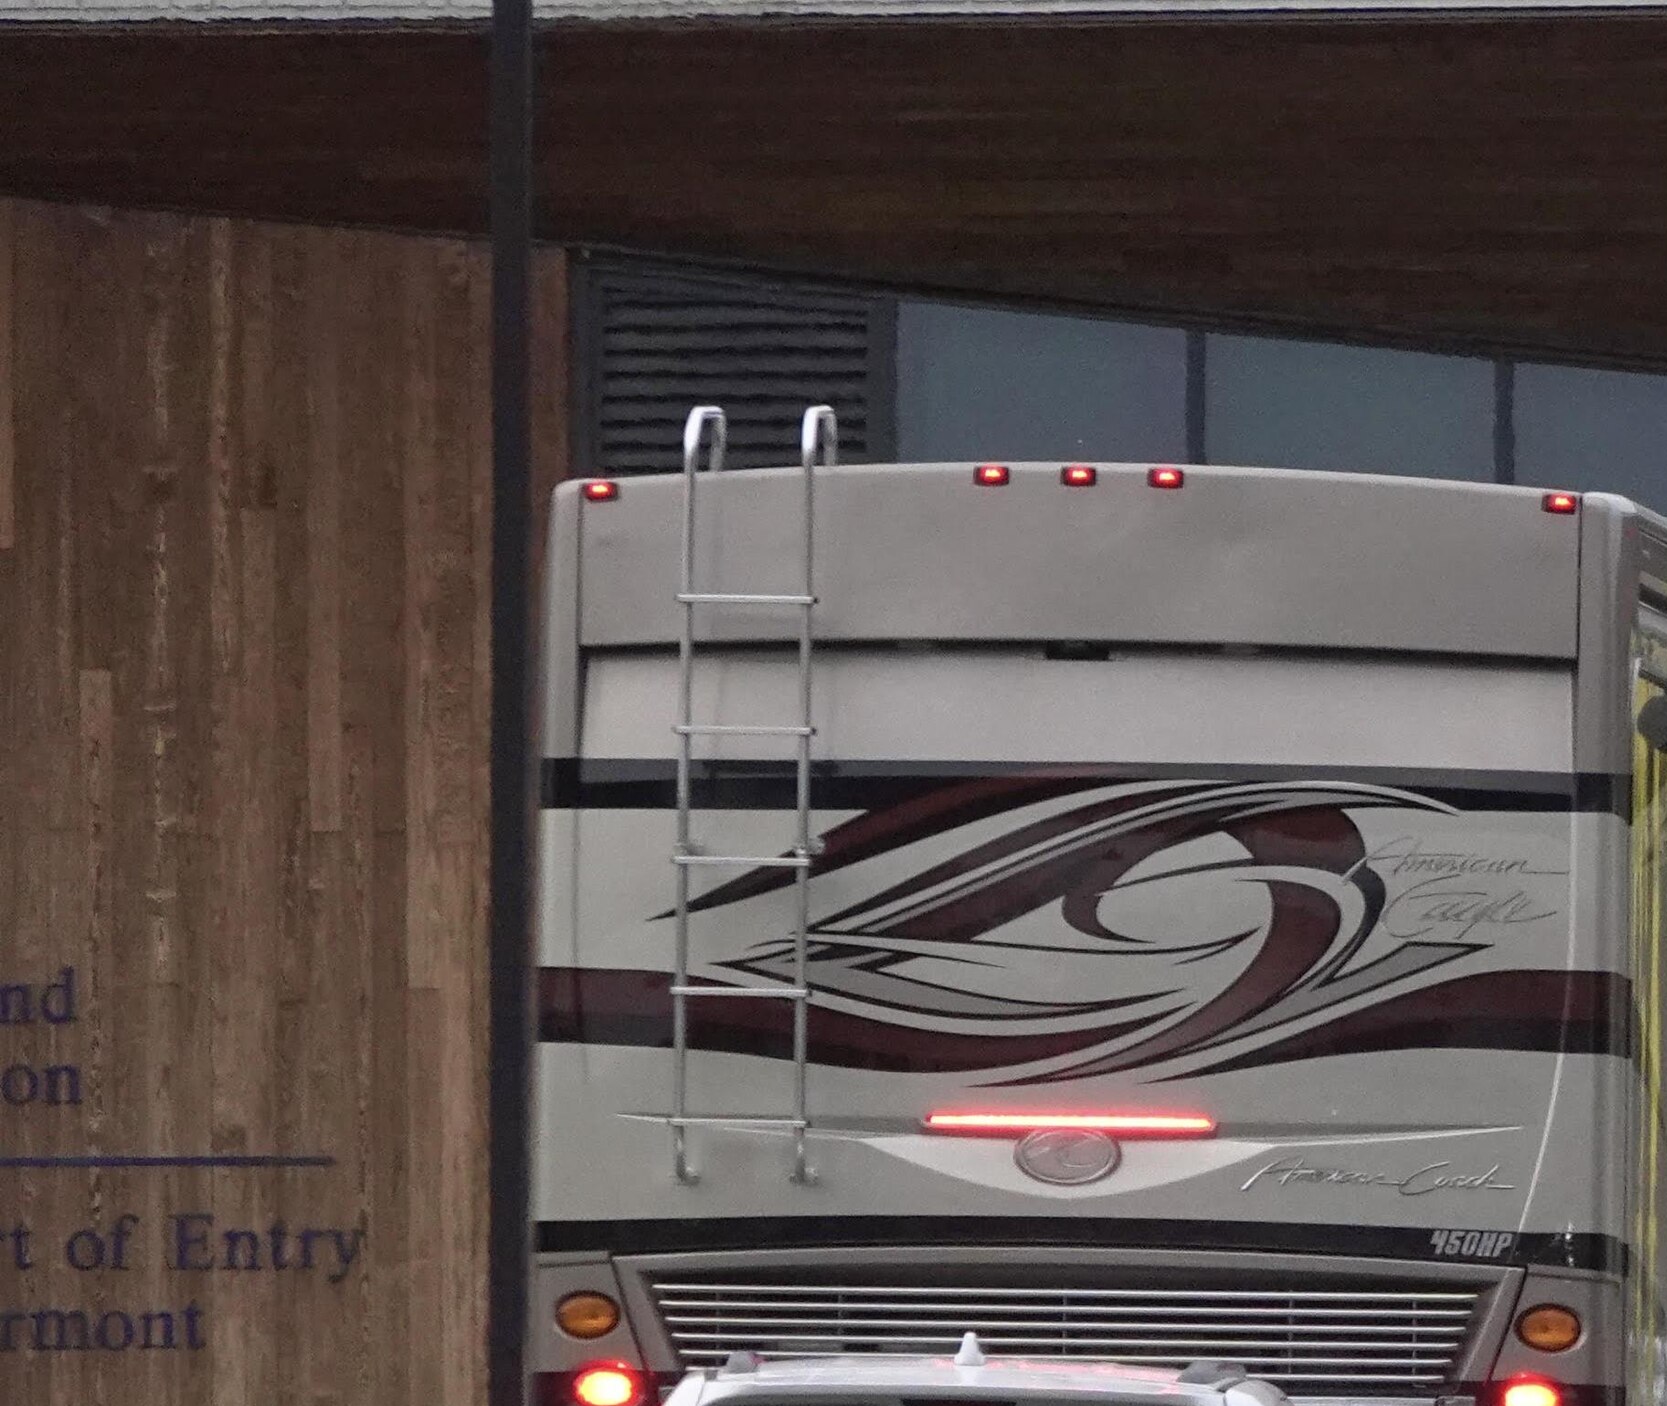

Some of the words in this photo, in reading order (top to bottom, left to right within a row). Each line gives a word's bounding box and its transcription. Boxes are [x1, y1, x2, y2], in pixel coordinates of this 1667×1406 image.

[66, 1214, 139, 1271] of
[167, 1213, 367, 1284] Entry
[1430, 1230, 1512, 1257] 450HP
